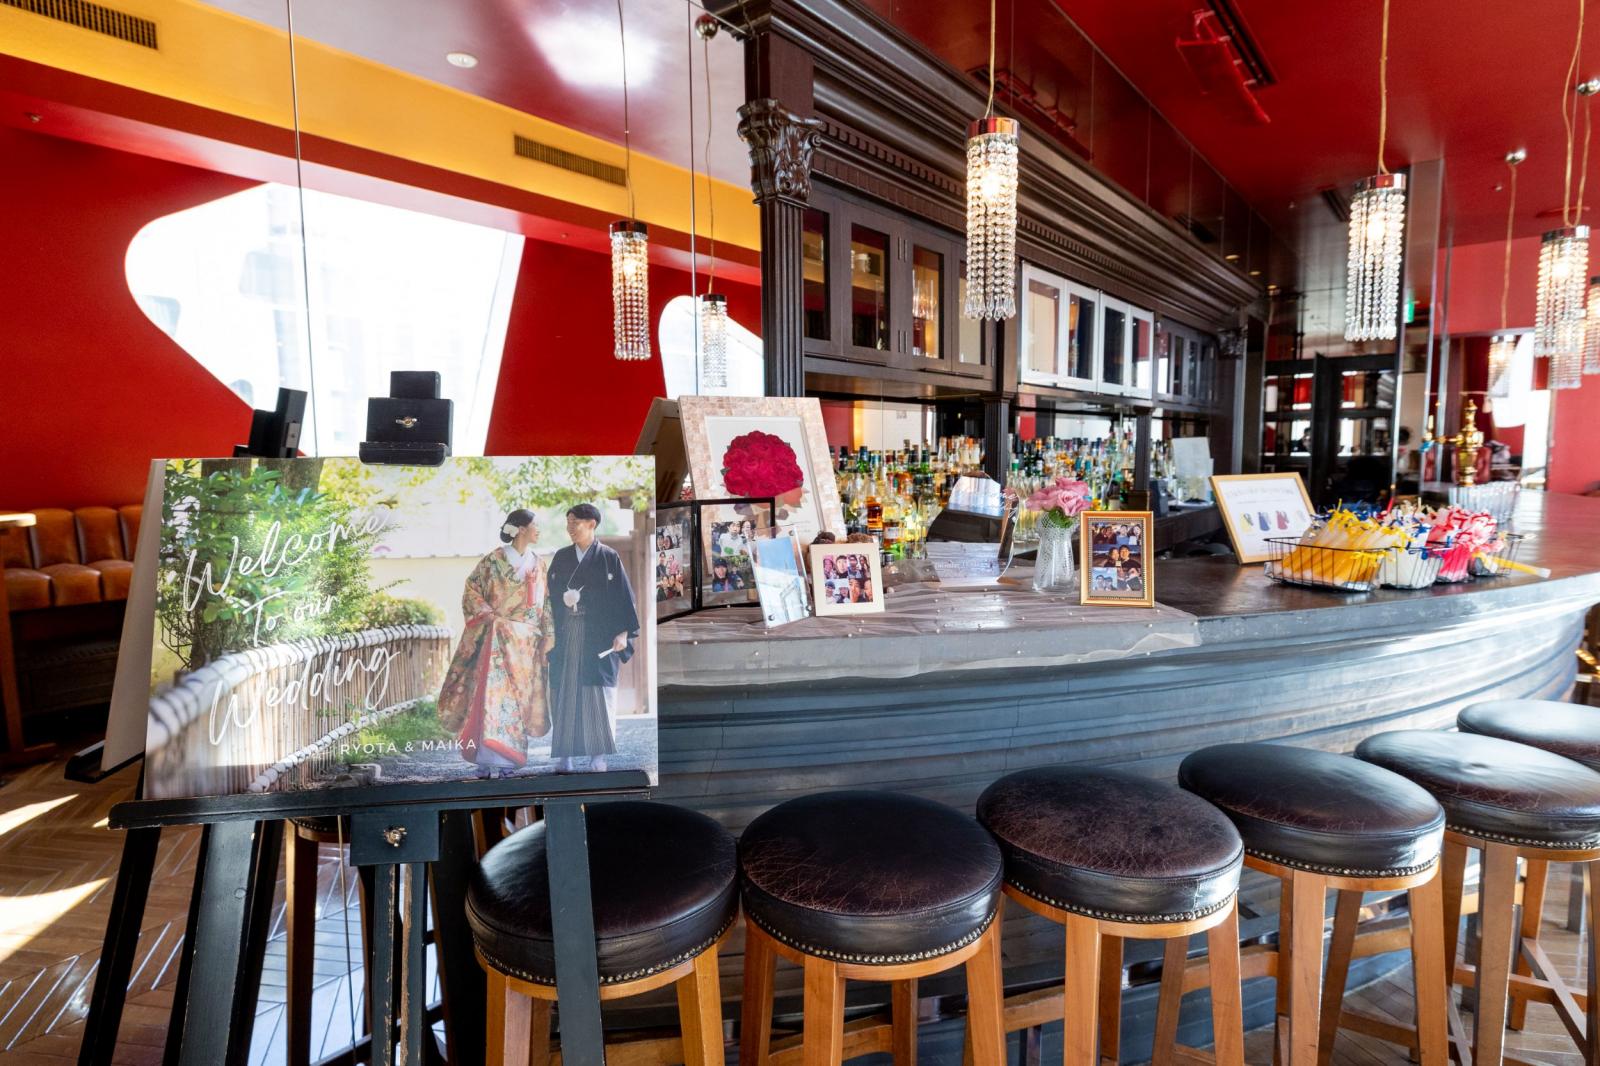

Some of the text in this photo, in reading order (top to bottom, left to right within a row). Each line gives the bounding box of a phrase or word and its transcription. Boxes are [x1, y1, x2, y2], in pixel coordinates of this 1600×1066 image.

[183, 512, 390, 612] Welcome
[293, 593, 341, 622] our
[208, 643, 401, 746] Wedding
[340, 739, 477, 755] RYOTA & MAIKA
